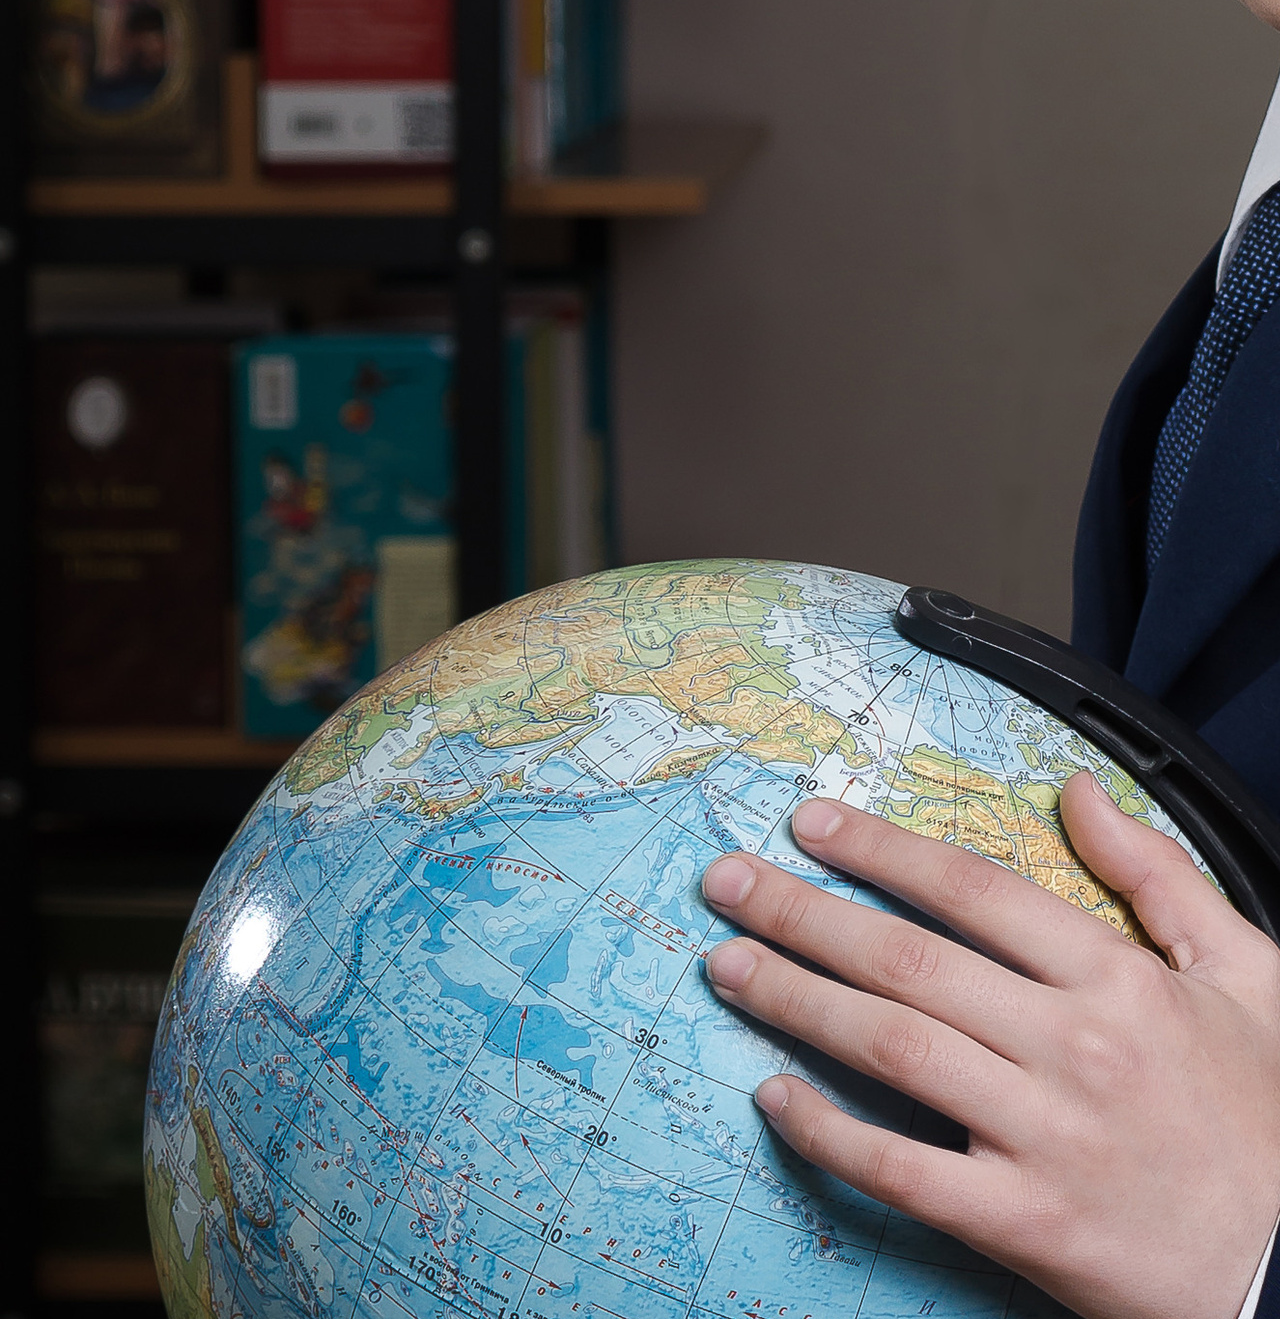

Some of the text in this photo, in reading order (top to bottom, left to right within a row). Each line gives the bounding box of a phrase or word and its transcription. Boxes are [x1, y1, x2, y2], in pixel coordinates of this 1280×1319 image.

[889, 663, 921, 679] 80°
[616, 699, 672, 748] ОХОТСКОЕ
[848, 710, 879, 726] 70°
[601, 733, 634, 761] МОРЕ
[974, 734, 1011, 749] МОРЕ
[666, 746, 721, 773] Камчатка
[742, 765, 804, 804] БЕРИН
[794, 774, 827, 791] 60°
[901, 766, 944, 786] Северный
[946, 781, 986, 798] полярный
[521, 792, 596, 809] Курильские
[711, 784, 771, 823] Командорские
[419, 850, 549, 883] ТЕЧЕНИЕ КУРОСИО
[634, 1028, 669, 1050] 30°
[221, 1080, 244, 1108] 140°
[535, 1058, 608, 1104] Северный тропик
[266, 1136, 291, 1164] 150°
[583, 1124, 618, 1148] 20°
[331, 1200, 362, 1228] 160°
[494, 1176, 665, 1269] СЕВЕРНОЕ
[539, 1220, 572, 1244] 10°
[408, 1256, 441, 1280] 170°
[469, 1274, 510, 1304] Гринвича
